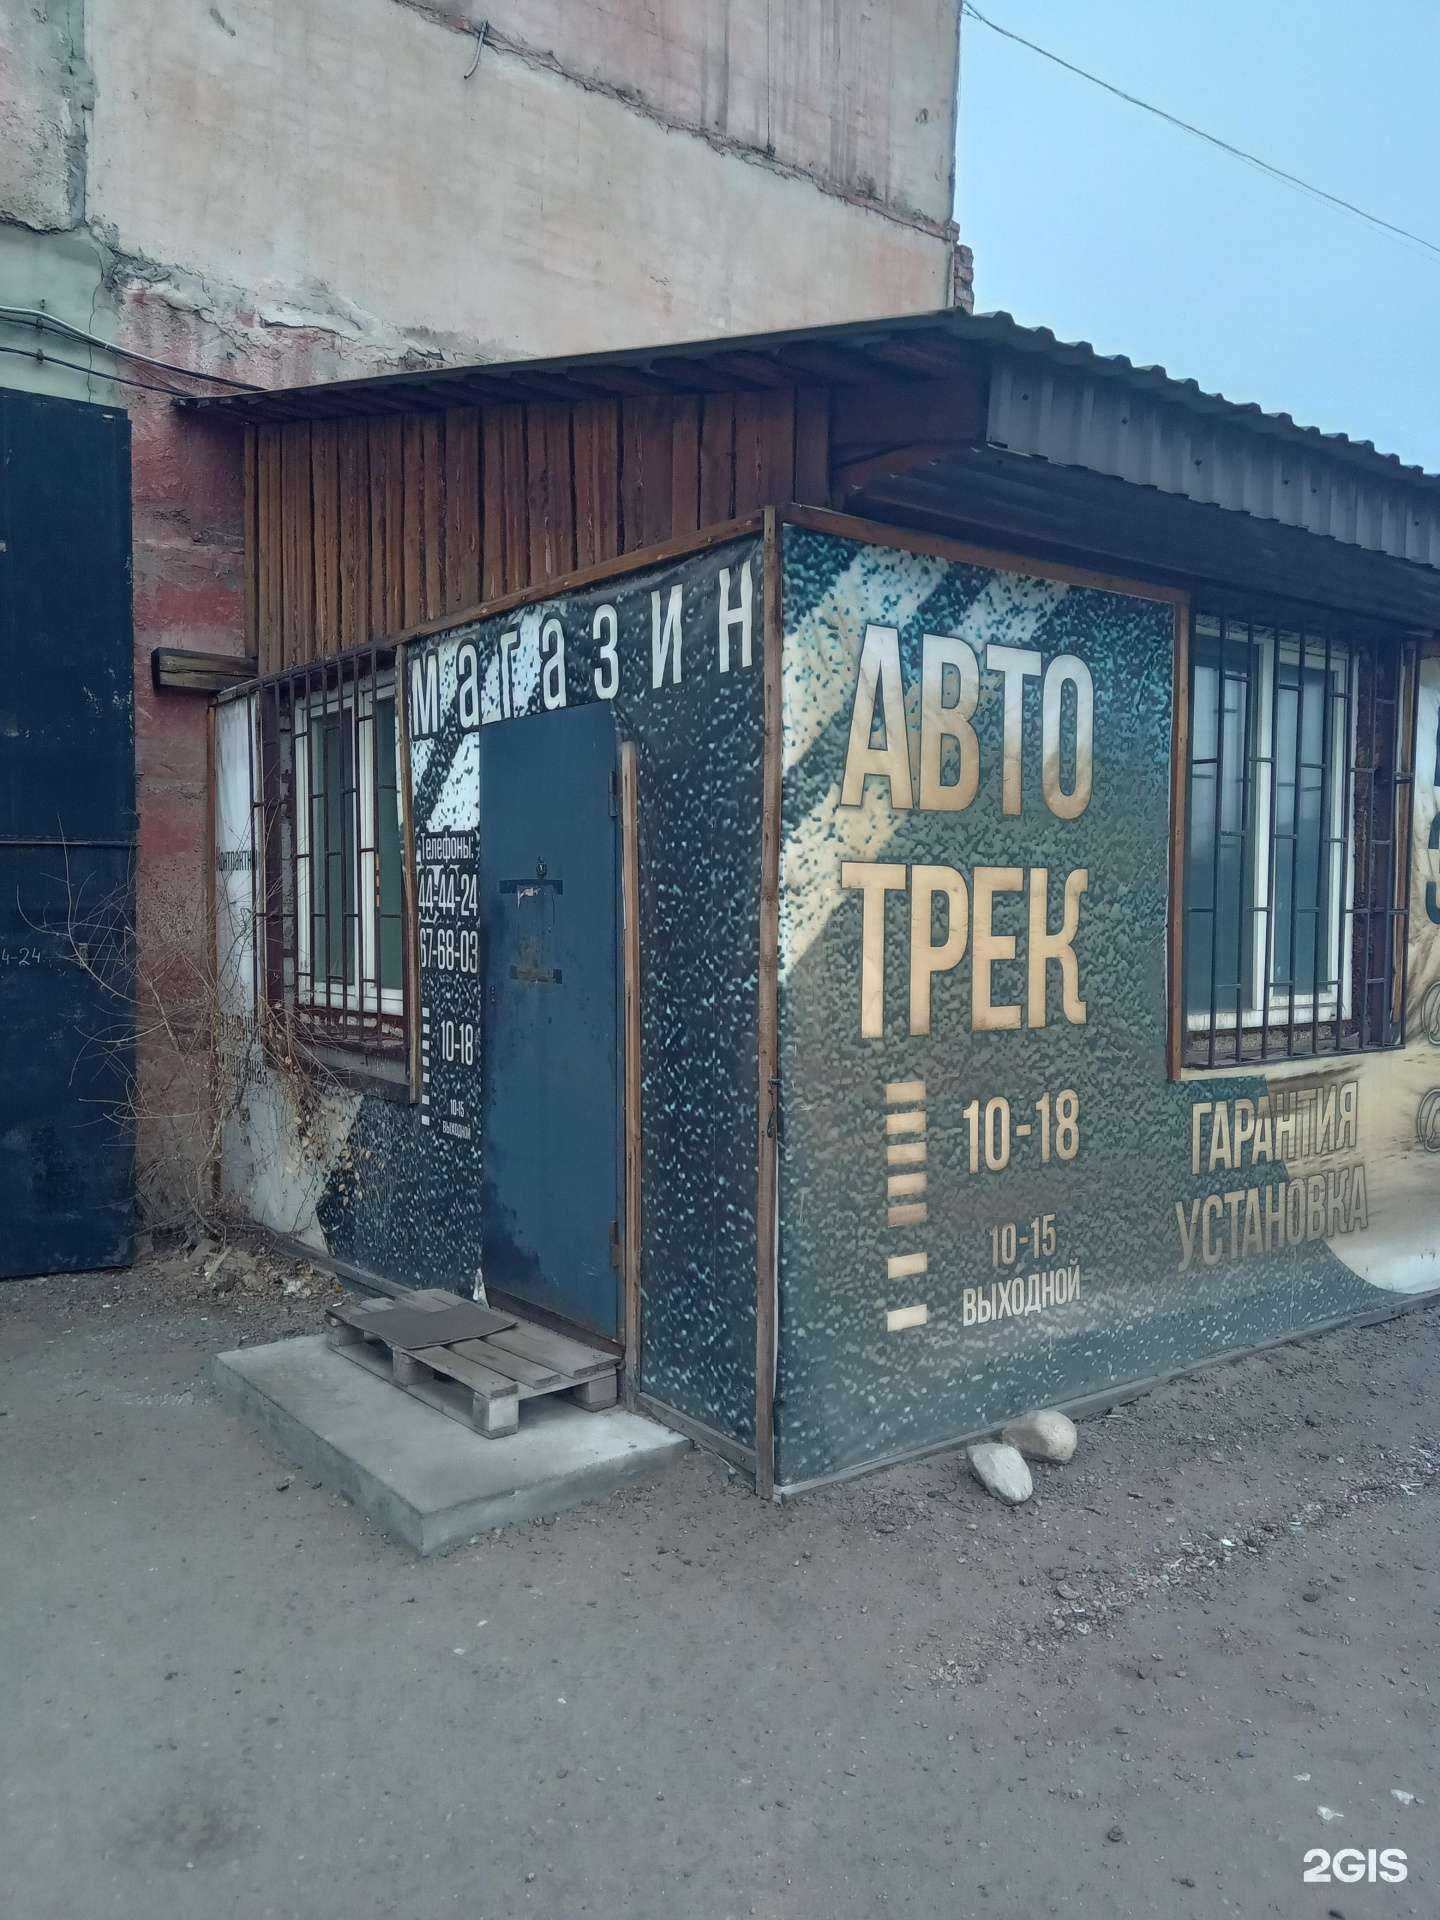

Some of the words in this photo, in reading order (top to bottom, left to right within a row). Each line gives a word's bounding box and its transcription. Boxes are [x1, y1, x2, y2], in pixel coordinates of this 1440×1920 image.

[839, 622, 1095, 820] АВТО
[420, 831, 474, 863] Телефоны:
[418, 873, 478, 917] 44-44-24
[419, 927, 478, 974] 67-68-03
[840, 861, 1089, 1040] ТРЕК
[441, 1020, 474, 1066] 10-18
[449, 1098, 465, 1118] 10-15
[962, 1088, 1081, 1174] 10-18
[1191, 1080, 1359, 1176] ГАРАНТИЯ
[989, 1213, 1057, 1267] 10-15
[1175, 1165, 1369, 1273] УСТАНОВКА
[962, 1257, 1081, 1327] ВЫХОДНОЙ
